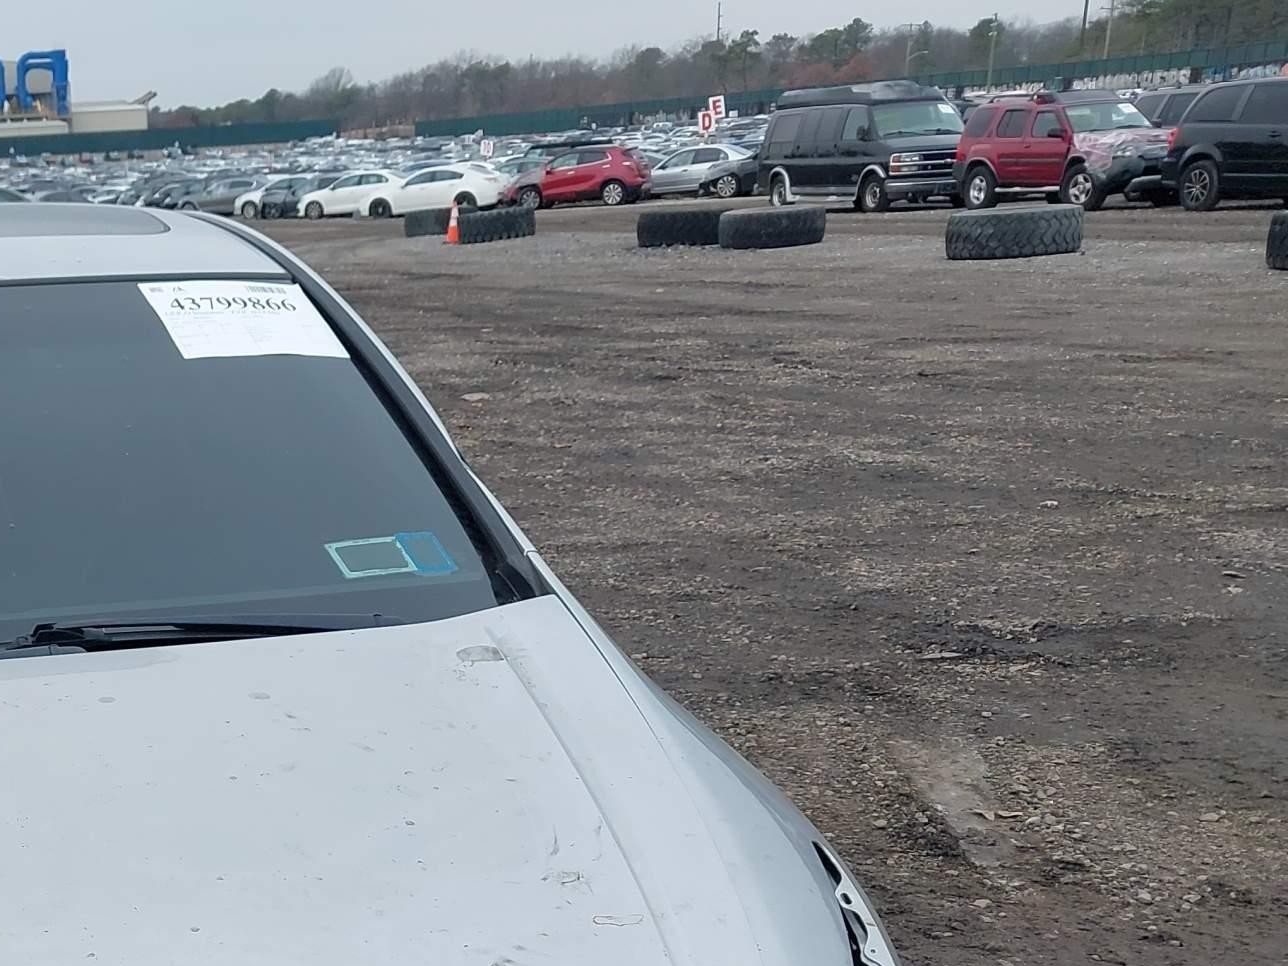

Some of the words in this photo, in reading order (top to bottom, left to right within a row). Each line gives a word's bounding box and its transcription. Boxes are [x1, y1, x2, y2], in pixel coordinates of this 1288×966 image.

[712, 99, 723, 115] E
[702, 112, 712, 131] D
[170, 296, 297, 311] 43799866
